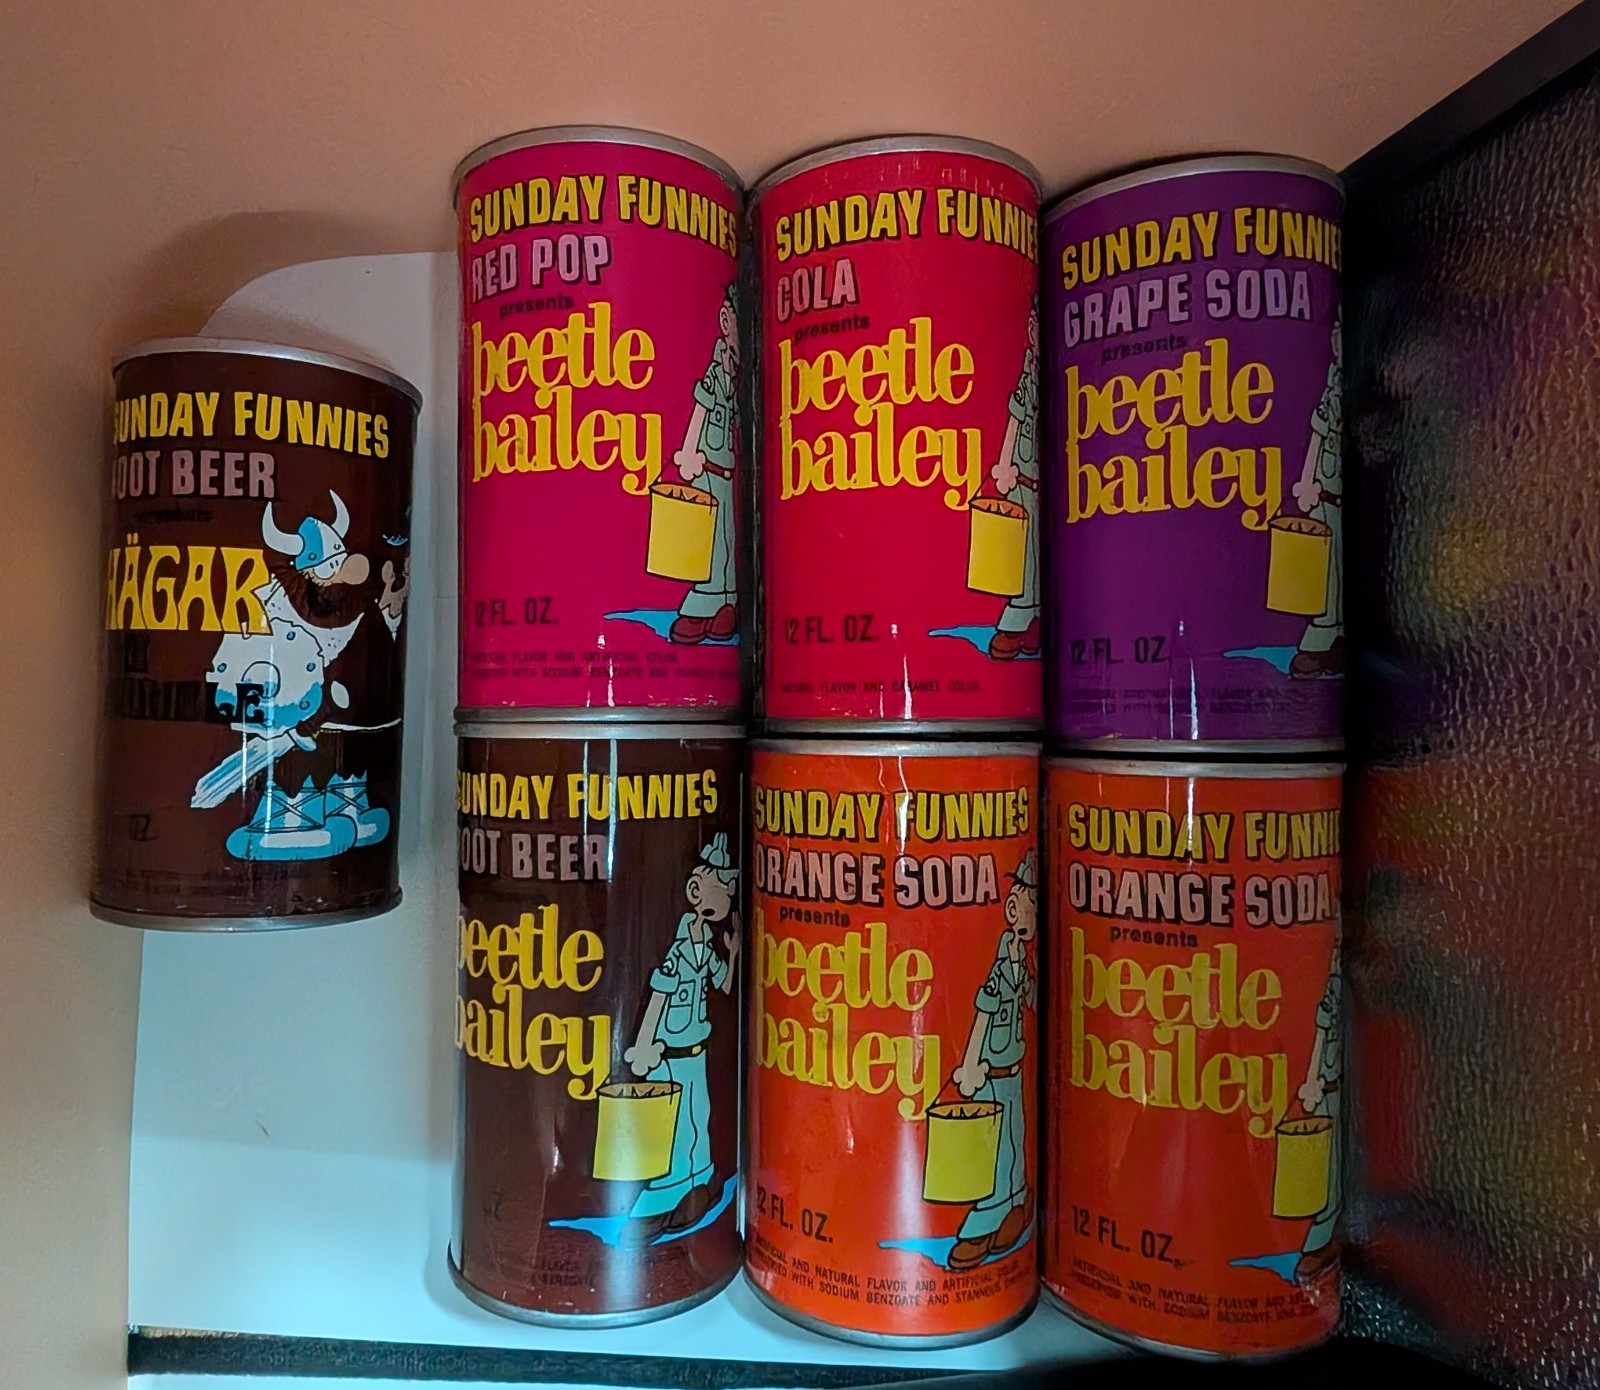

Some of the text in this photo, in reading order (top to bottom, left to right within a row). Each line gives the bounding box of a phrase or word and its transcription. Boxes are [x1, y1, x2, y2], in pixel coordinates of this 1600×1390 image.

[470, 175, 737, 258] SUNDAY FUNNIES
[776, 189, 923, 262] SUNDAY
[1062, 207, 1342, 290] SUNDAY FUNNIE
[472, 234, 609, 302] RED POP
[777, 258, 856, 323] COLA
[500, 293, 575, 318] presents
[794, 314, 870, 344] presents
[1064, 268, 1311, 348] GRAPE SODA
[471, 302, 656, 398] beetle
[779, 317, 974, 420] beetle
[1065, 337, 1274, 442] beetle
[234, 391, 389, 459] FUNNIES
[471, 384, 662, 496] bailey
[779, 402, 981, 511] bailey
[172, 450, 275, 498] BEER
[1065, 424, 1282, 531] bailey
[105, 532, 273, 635] HÄGAR
[567, 769, 718, 821] FUNNIES
[755, 786, 1028, 841] SUNDAY FUNNIES
[460, 827, 611, 882] OOT BEER
[1069, 803, 1231, 859] SUNDAY
[755, 843, 998, 907] ORANGE SODA
[1069, 863, 1330, 926] ORANGE SODA
[780, 905, 850, 928] presents
[1110, 926, 1198, 949] presents
[756, 907, 933, 1011] beetle
[1070, 926, 1282, 1030] beetle
[755, 987, 940, 1121] bailey
[1070, 1008, 1288, 1139] bailey
[771, 1193, 793, 1230] FL.
[801, 1207, 835, 1244] OZ.
[1071, 1204, 1091, 1237] 12
[1098, 1215, 1131, 1252] FL.
[792, 1257, 809, 1273] AND
[815, 1265, 861, 1288] NATURAL
[867, 1278, 908, 1293] FLAVOR
[915, 1279, 936, 1292] AND
[792, 1270, 815, 1289] WITH
[819, 1281, 859, 1301] SODIUM
[866, 1292, 921, 1307] BENZOATE
[927, 1293, 950, 1306] AND
